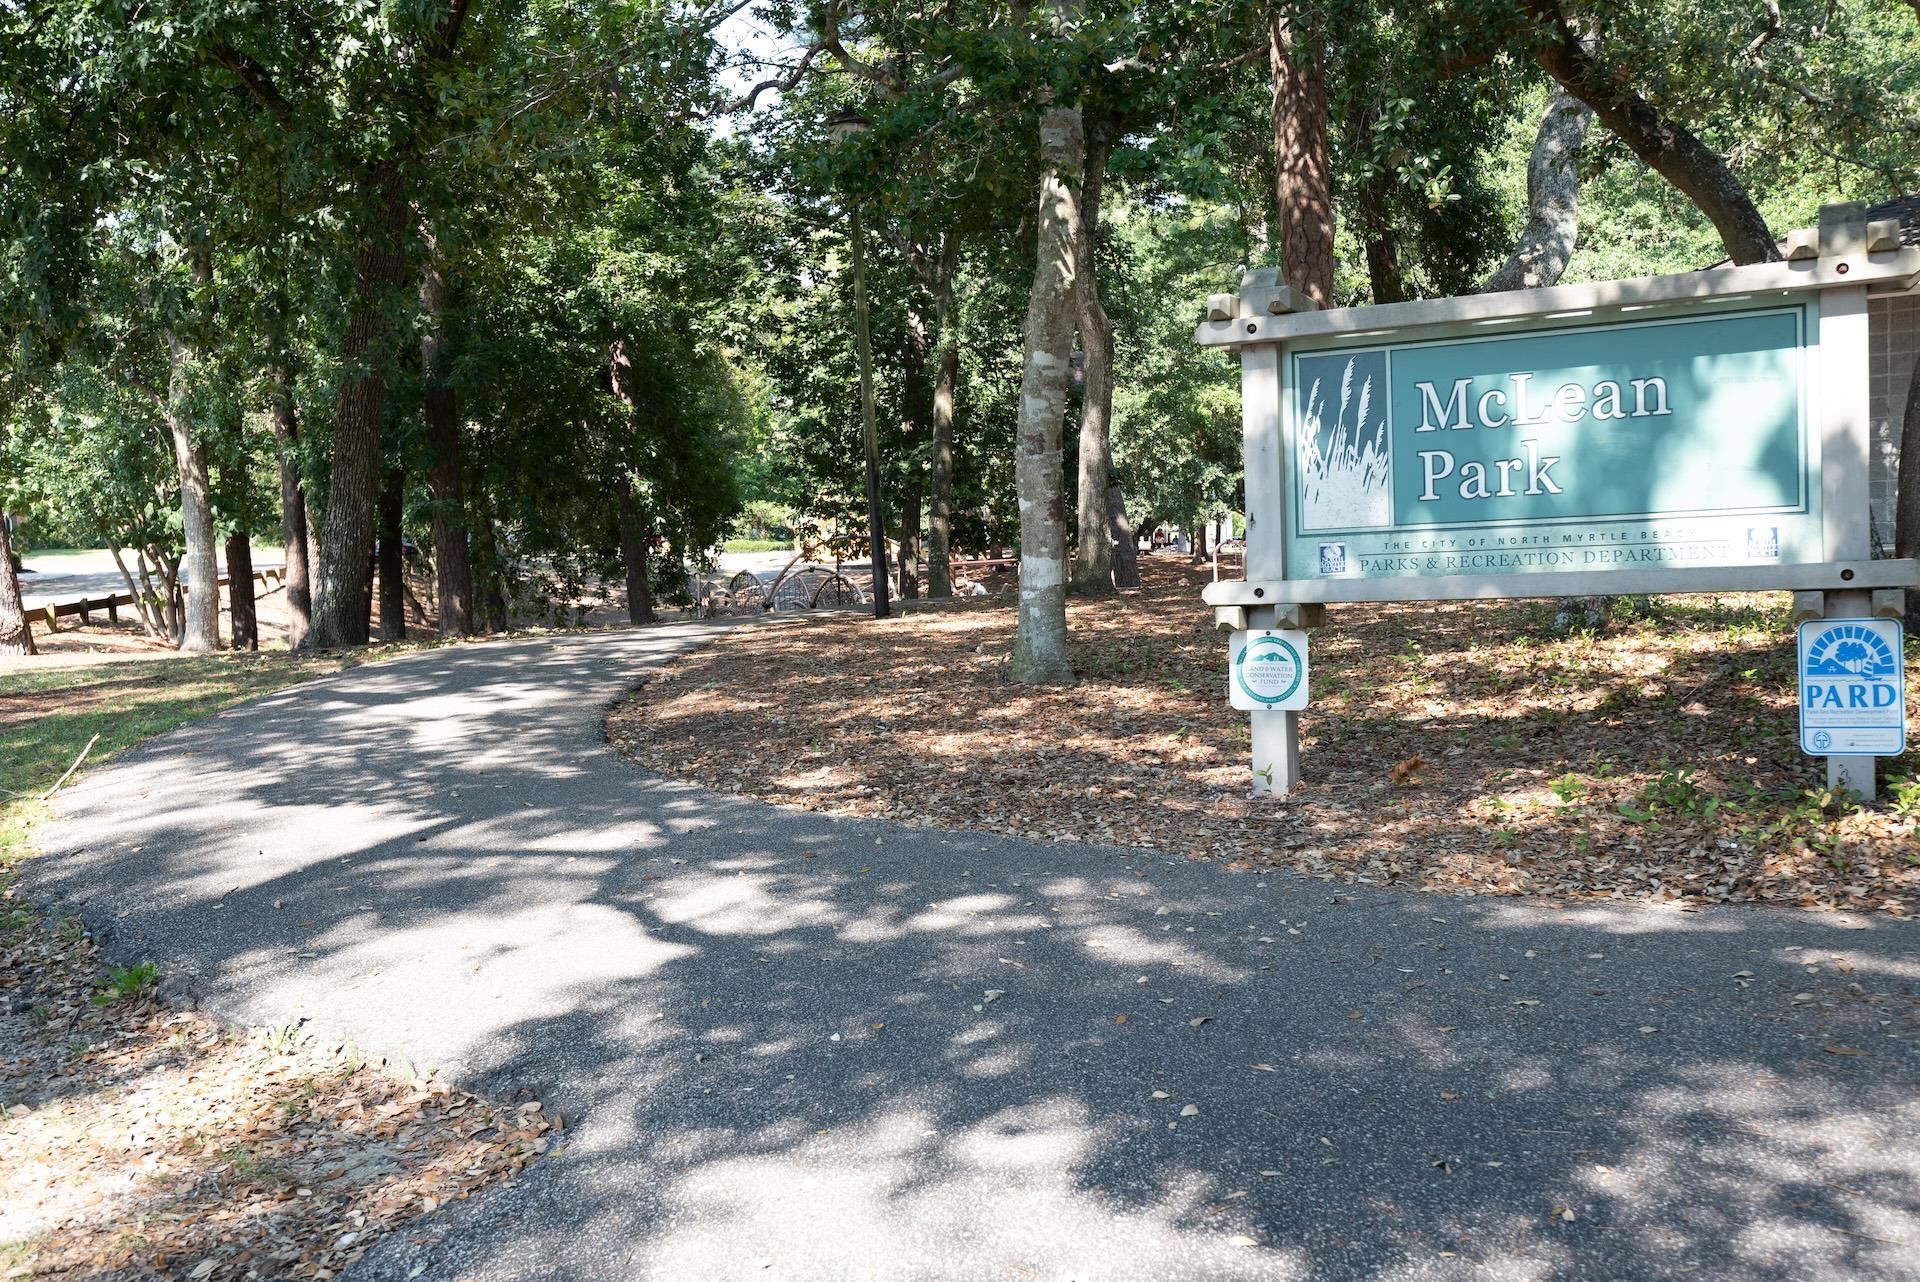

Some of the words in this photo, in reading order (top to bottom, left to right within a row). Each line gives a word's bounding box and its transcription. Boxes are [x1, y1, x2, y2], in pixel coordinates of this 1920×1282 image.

[1414, 371, 1673, 433] McLean
[1417, 438, 1563, 501] Park
[1383, 541, 1411, 550] THE
[1422, 539, 1457, 549] CITY
[1468, 537, 1487, 547] OF
[1497, 535, 1551, 546] NORTH
[1562, 532, 1628, 543] MYRTLE
[1359, 556, 1419, 572] PARKS
[1426, 556, 1438, 570] &
[1446, 552, 1575, 569] RECREATION
[1583, 545, 1731, 564] DEPARTMENT
[1269, 665, 1293, 673] WATER
[1807, 684, 1897, 708] PARD
